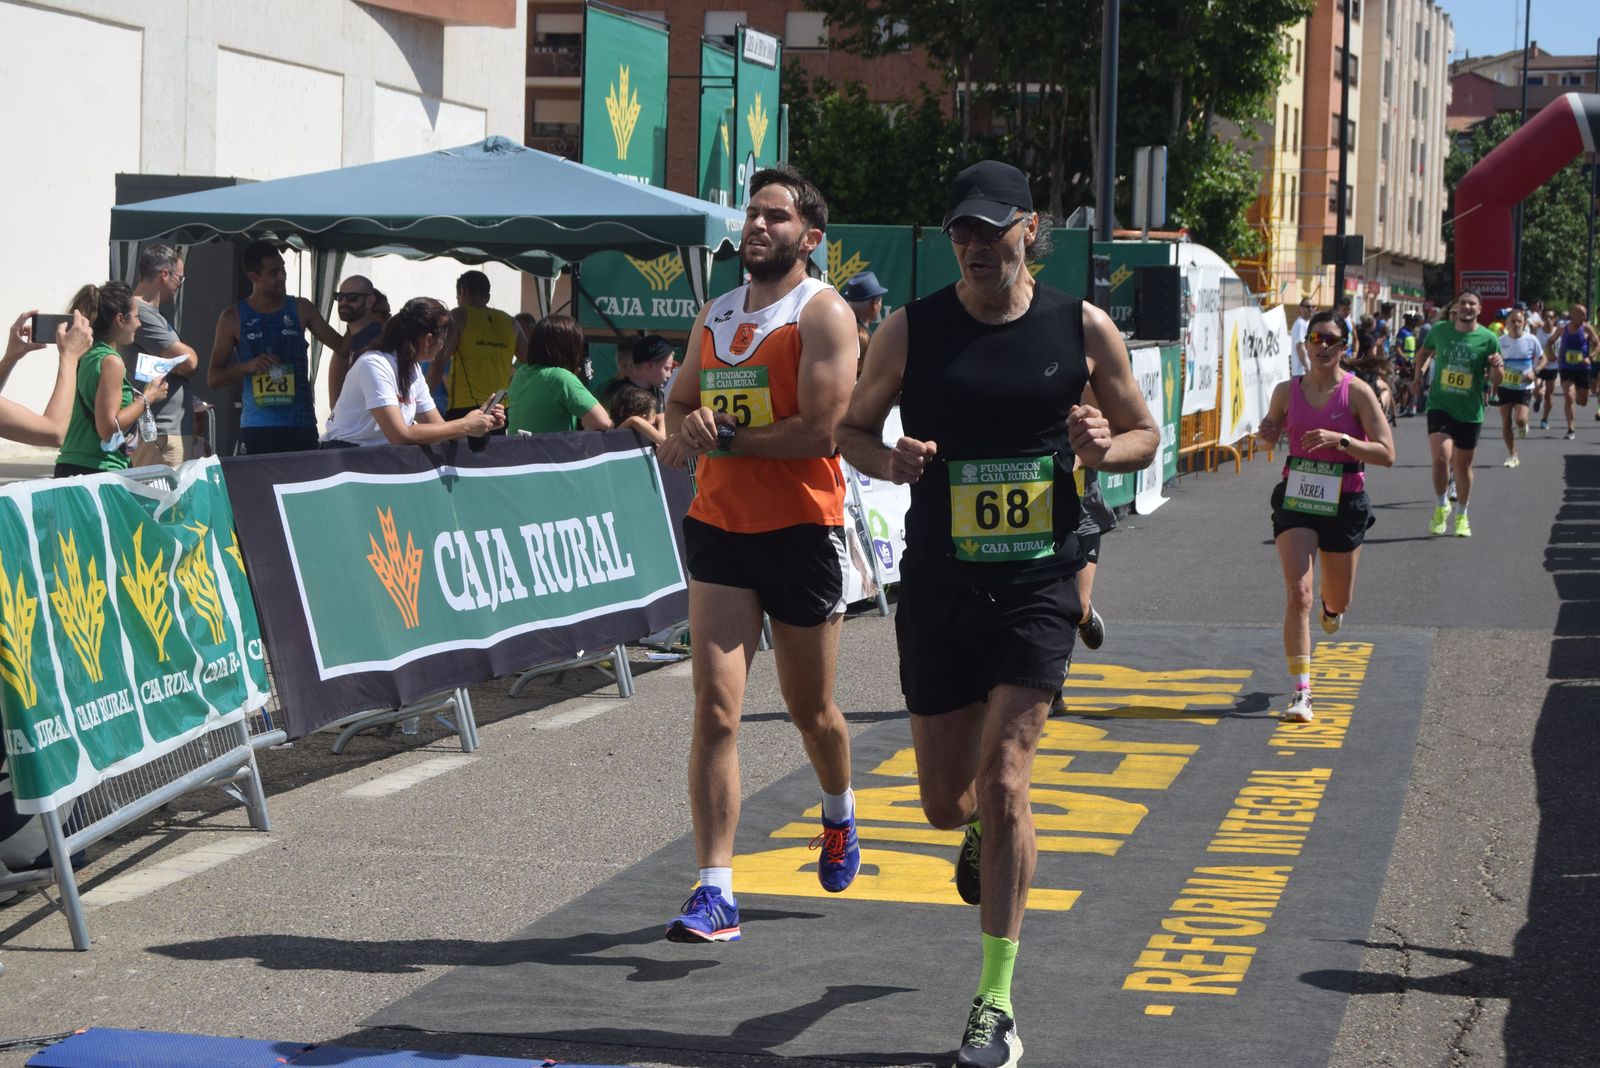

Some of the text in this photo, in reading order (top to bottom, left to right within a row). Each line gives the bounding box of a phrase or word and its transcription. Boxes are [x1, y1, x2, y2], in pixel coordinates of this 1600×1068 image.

[593, 296, 699, 318] CAJA RUR
[256, 376, 288, 393] 128
[716, 379, 758, 388] CAJA RURAL
[1448, 373, 1465, 386] 66
[980, 471, 1041, 482] CAJA RURAL
[1297, 483, 1325, 499] NEREA
[975, 489, 1030, 530] 68
[981, 540, 1047, 554] CAJA RURAL
[433, 511, 636, 613] CAJA RURAL
[1310, 641, 1374, 699] INTERIORES
[75, 688, 135, 731] CAJA RURAL
[1205, 767, 1333, 856] INTEGRAL
[1121, 865, 1294, 996] REFORMA
